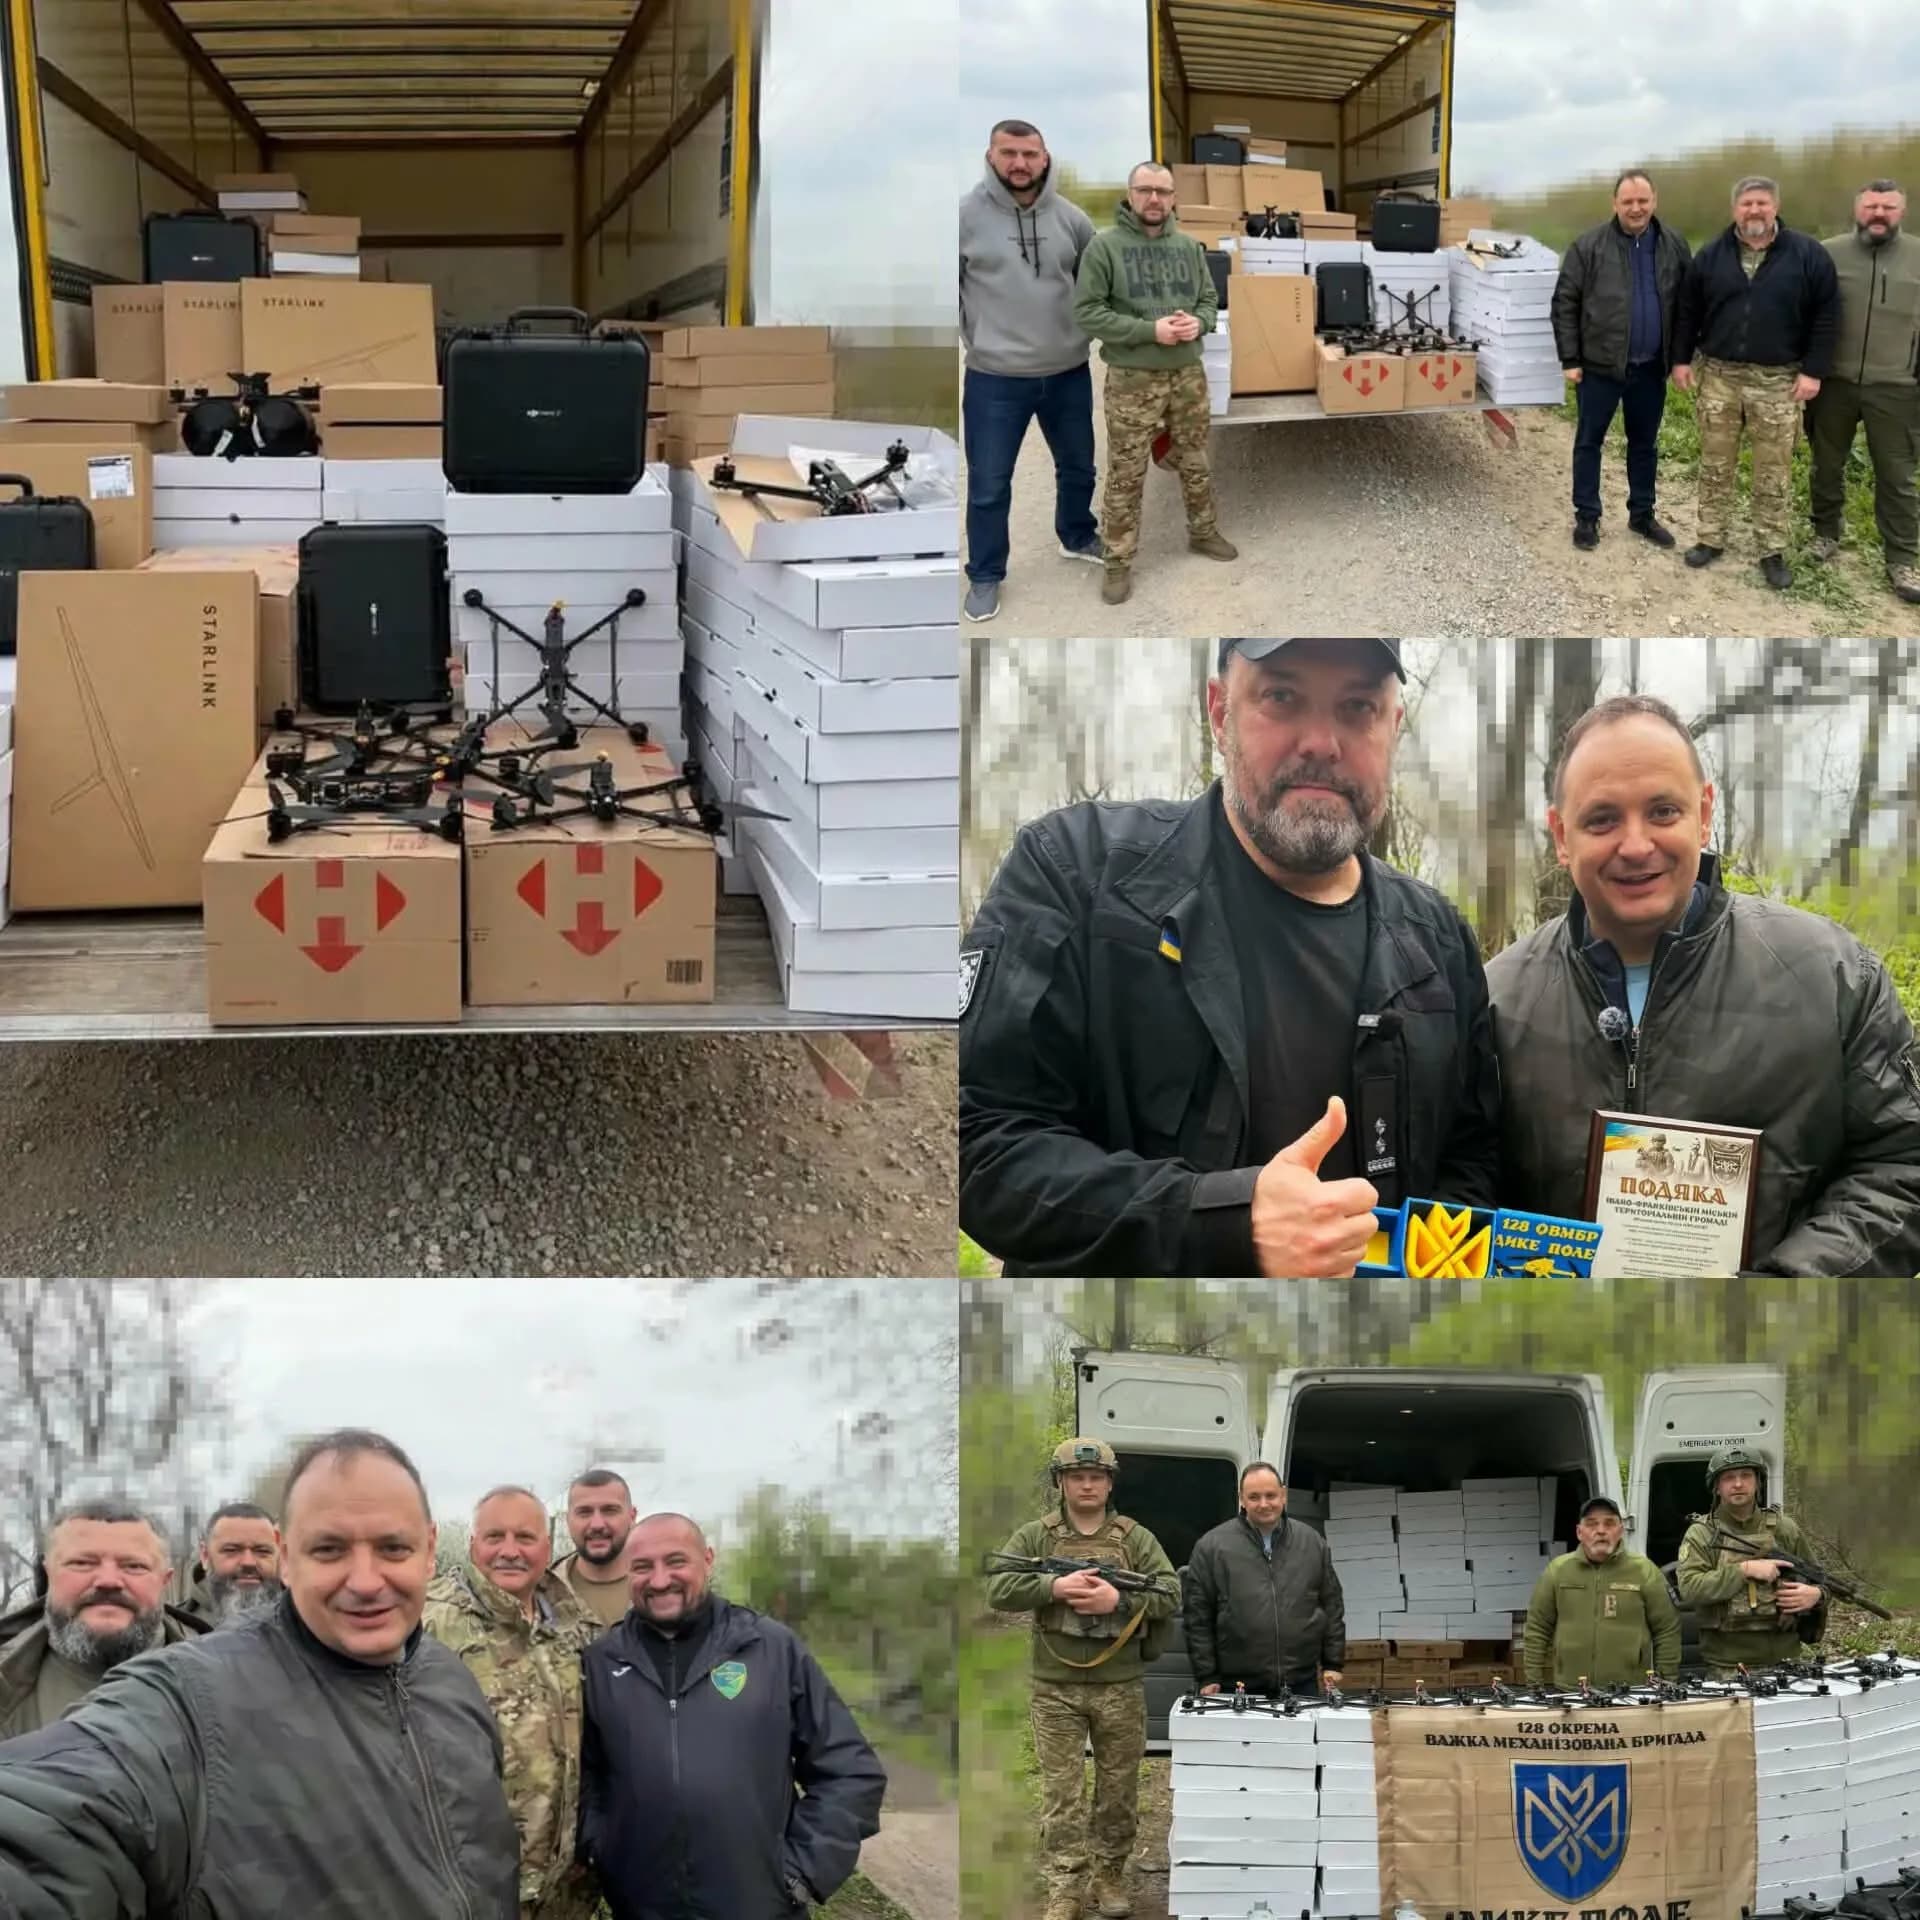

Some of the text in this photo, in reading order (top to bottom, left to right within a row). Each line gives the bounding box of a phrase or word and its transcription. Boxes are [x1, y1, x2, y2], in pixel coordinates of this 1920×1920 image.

[263, 298, 325, 308] STARLINK
[203, 605, 217, 708] STARLINK
[1619, 1176, 1728, 1206] ПОДЯКА
[1502, 1217, 1599, 1243] 128 ОВМБР
[1495, 1233, 1597, 1260] ДИКЕ ПОЛЕ
[1679, 1437, 1745, 1448] EMERGENCY DOOR
[1516, 1721, 1620, 1734] 128 ОКРЕМА
[1424, 1730, 1706, 1751] ВАЖКА МЕХАНІЗОВАНА БРИГАДА
